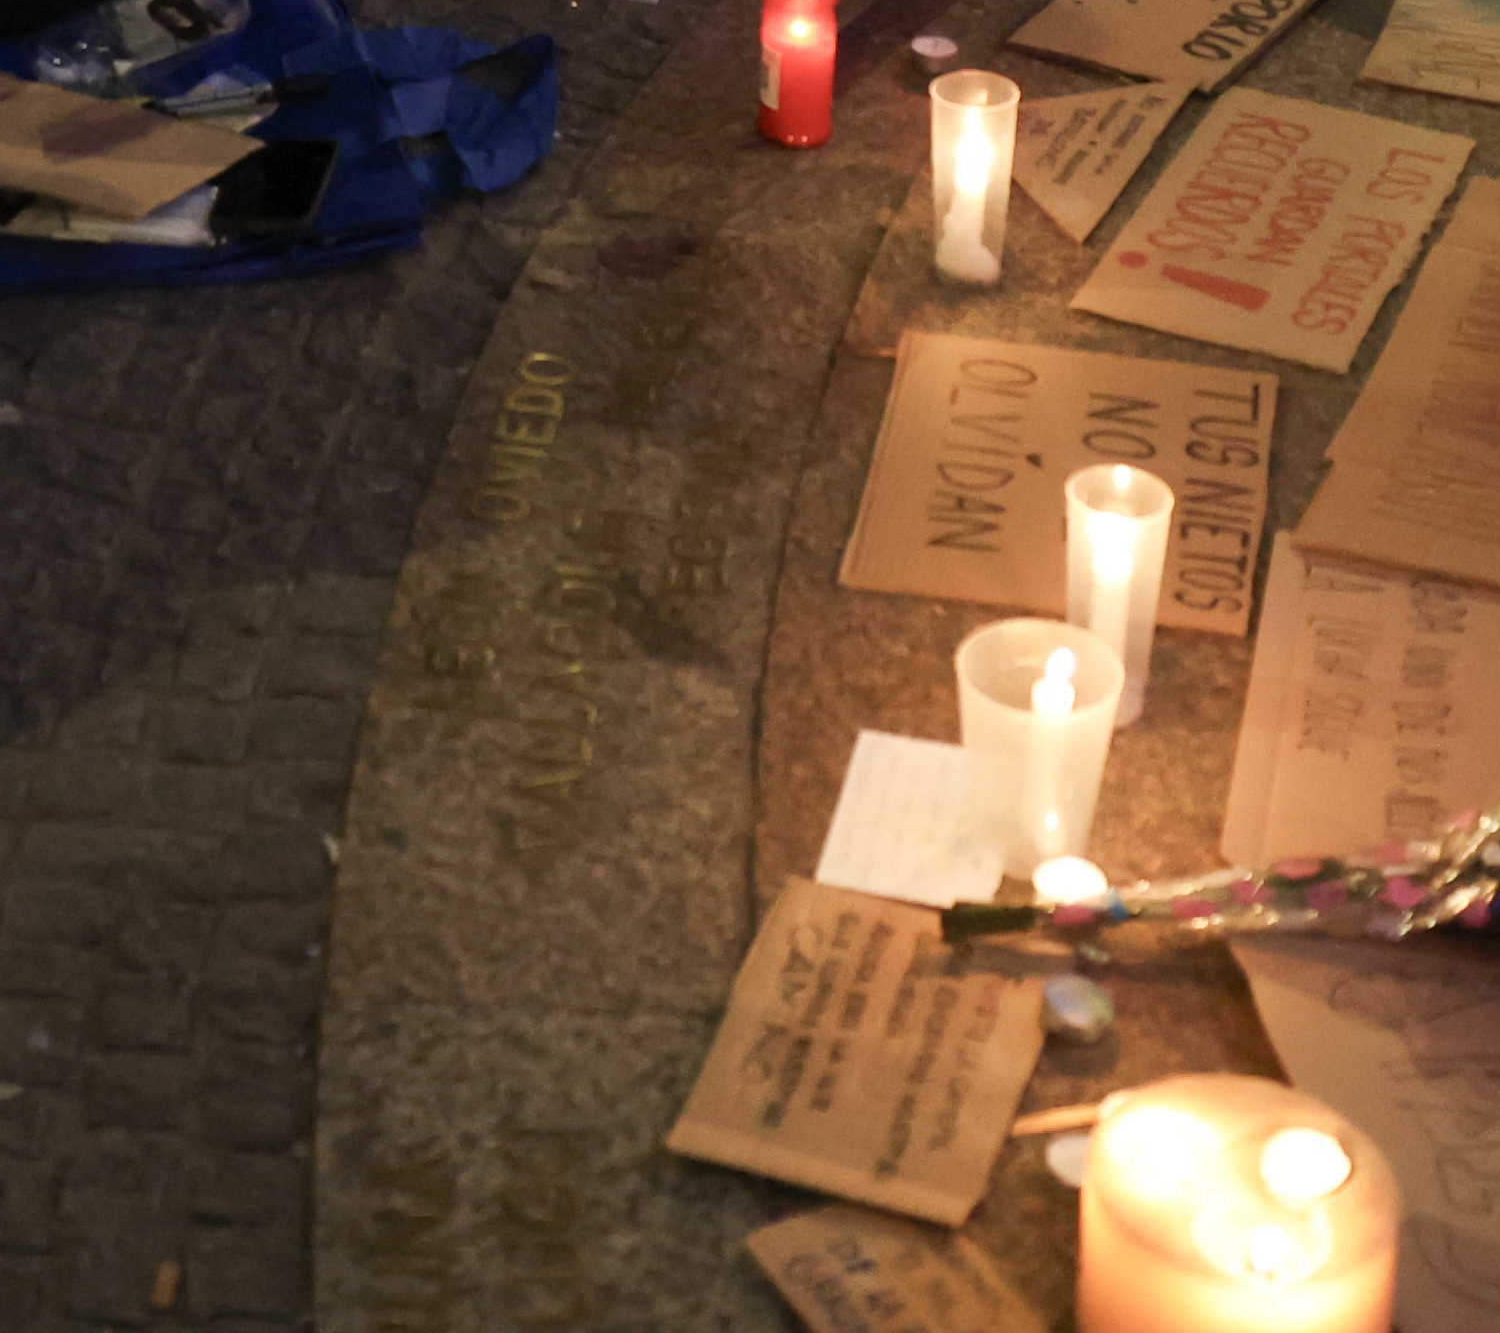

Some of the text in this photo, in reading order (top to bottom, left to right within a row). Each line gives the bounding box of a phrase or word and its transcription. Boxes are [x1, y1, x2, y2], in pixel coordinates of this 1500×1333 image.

[1183, 31, 1259, 63] LO
[1244, 157, 1352, 267] GUARDAN
[1291, 146, 1447, 336] LOS PORTALES
[468, 350, 576, 524] OVIEDO
[1080, 391, 1162, 461] NO
[1172, 382, 1262, 612] TUS NIETOS
